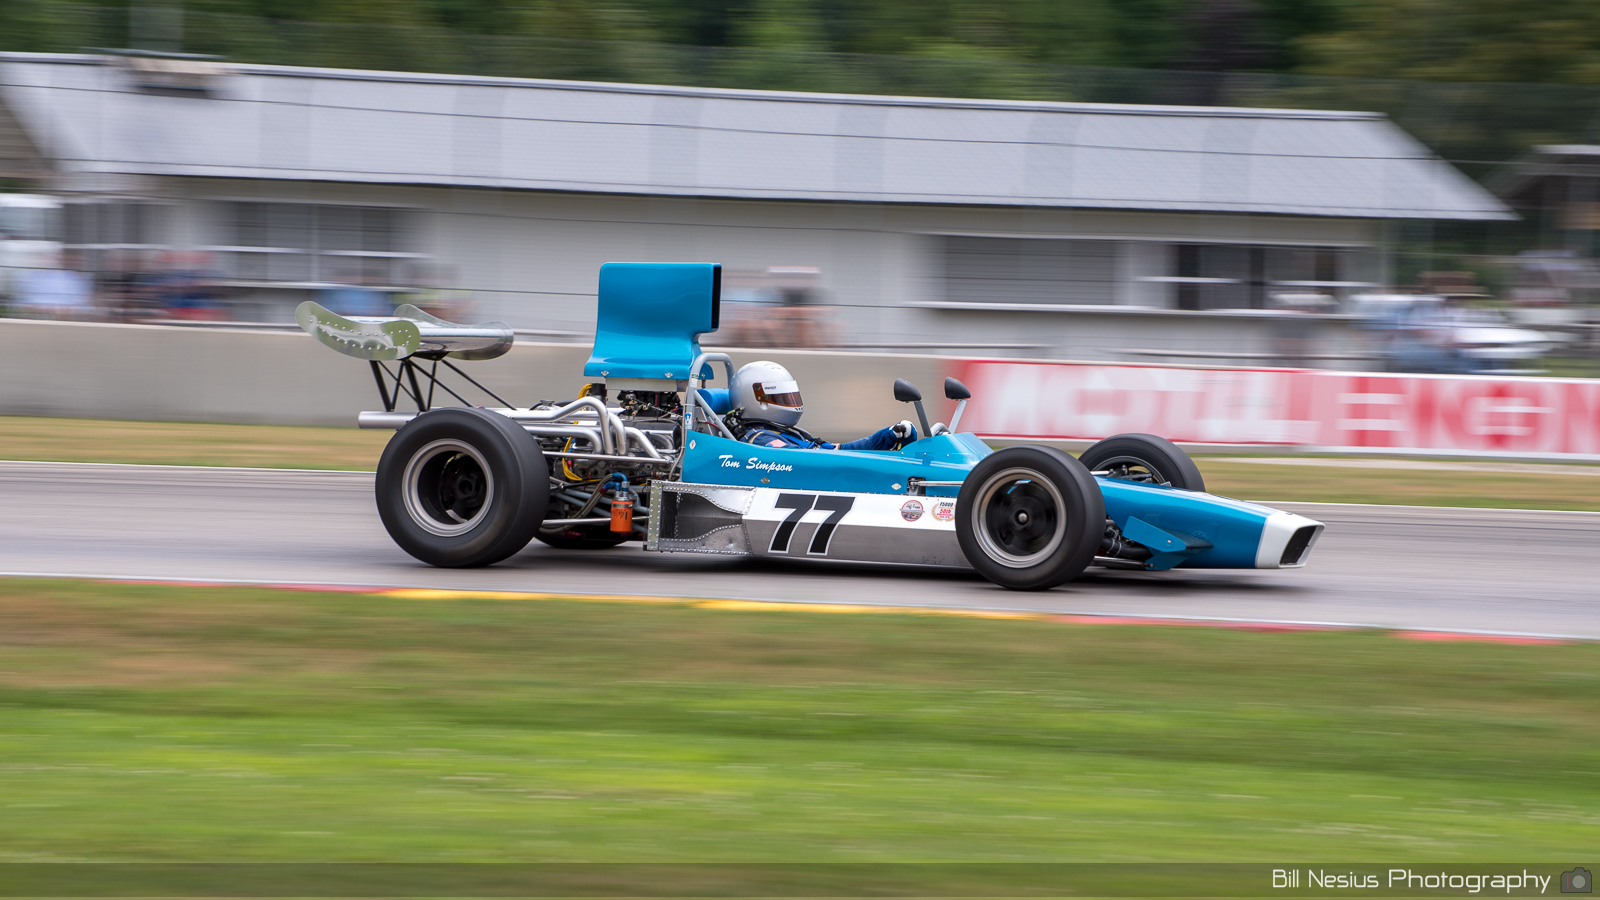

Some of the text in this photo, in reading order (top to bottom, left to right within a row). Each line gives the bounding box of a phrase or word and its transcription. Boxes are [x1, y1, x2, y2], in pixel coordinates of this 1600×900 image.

[719, 454, 793, 473] Tom Simpson
[767, 492, 856, 556] 77
